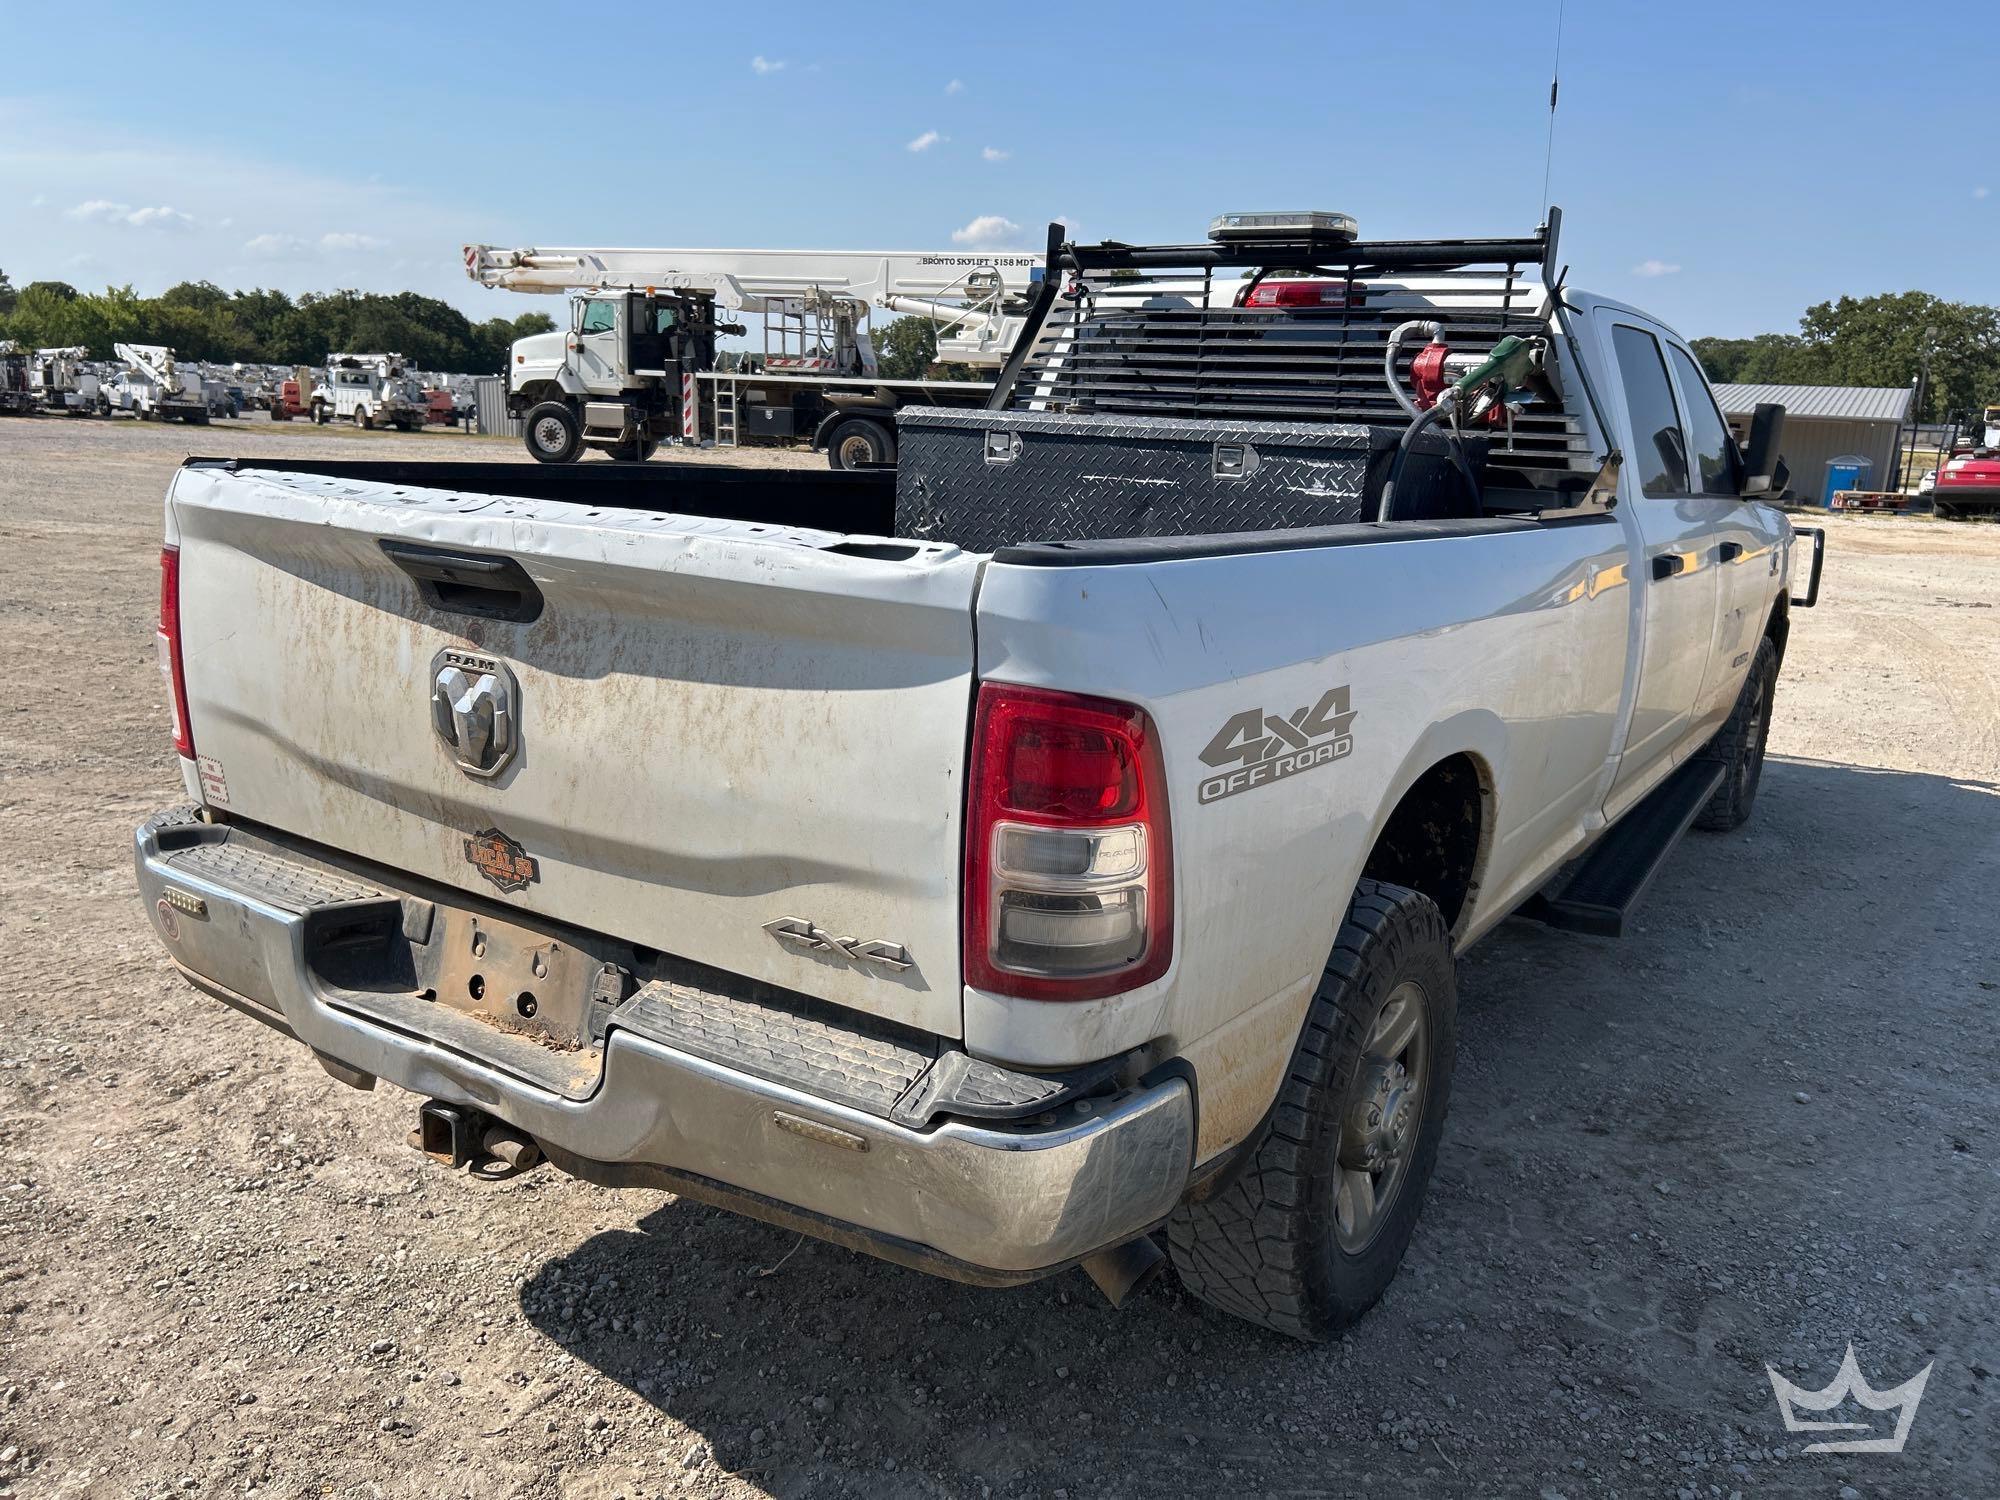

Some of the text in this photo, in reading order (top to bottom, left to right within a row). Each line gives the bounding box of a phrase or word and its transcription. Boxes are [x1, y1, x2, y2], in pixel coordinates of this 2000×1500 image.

[922, 257, 955, 266] BRONTO
[956, 258, 990, 266] SKYLIFT
[1015, 259, 1036, 267] MDT
[446, 653, 495, 671] RAM
[1202, 738, 1351, 801] OFF ROAD
[470, 843, 515, 873] LOCAL
